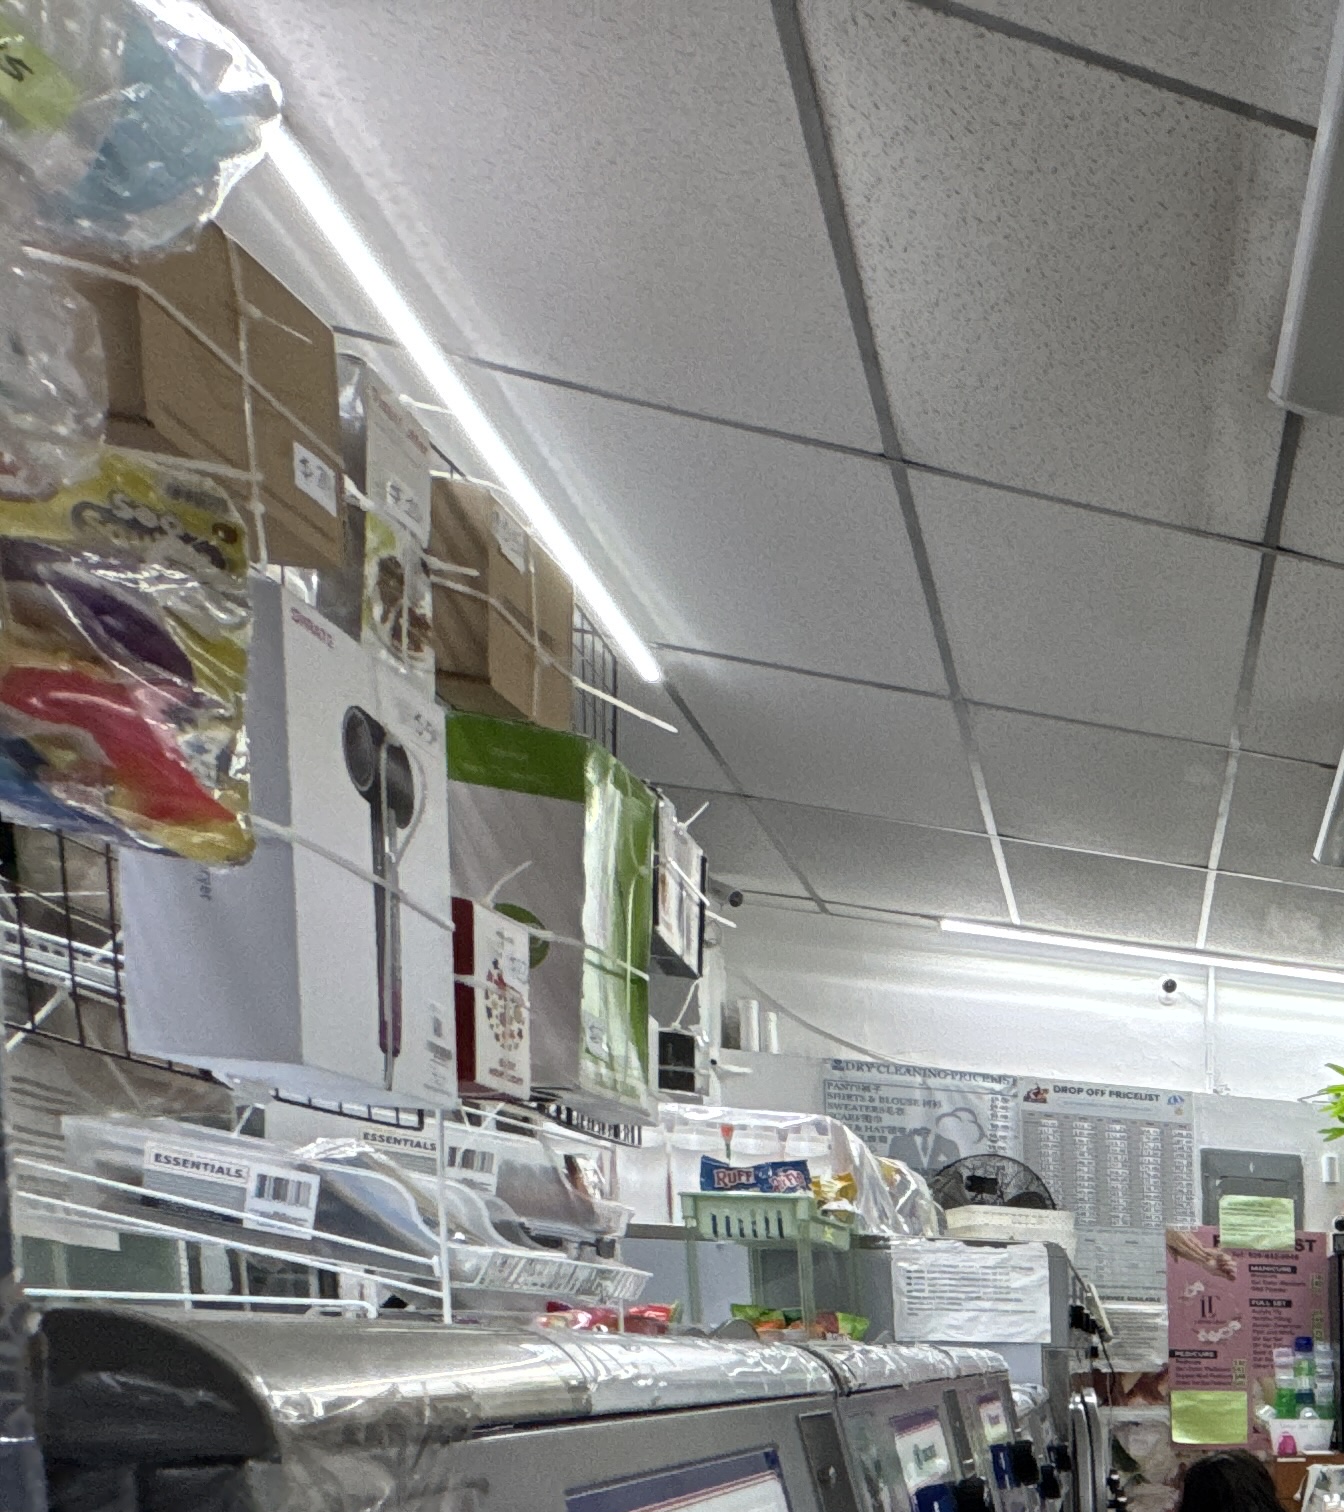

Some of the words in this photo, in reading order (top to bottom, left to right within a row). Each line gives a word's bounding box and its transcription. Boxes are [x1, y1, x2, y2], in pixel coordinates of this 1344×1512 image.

[846, 1061, 875, 1073] DRY
[877, 1064, 948, 1080] CLEANING
[1053, 1085, 1083, 1095] DROP
[1086, 1088, 1106, 1097] OFF
[1109, 1090, 1160, 1101] PRICELIST
[363, 1131, 436, 1151] ESSENTIALS
[154, 1153, 244, 1179] ESSENTIALS
